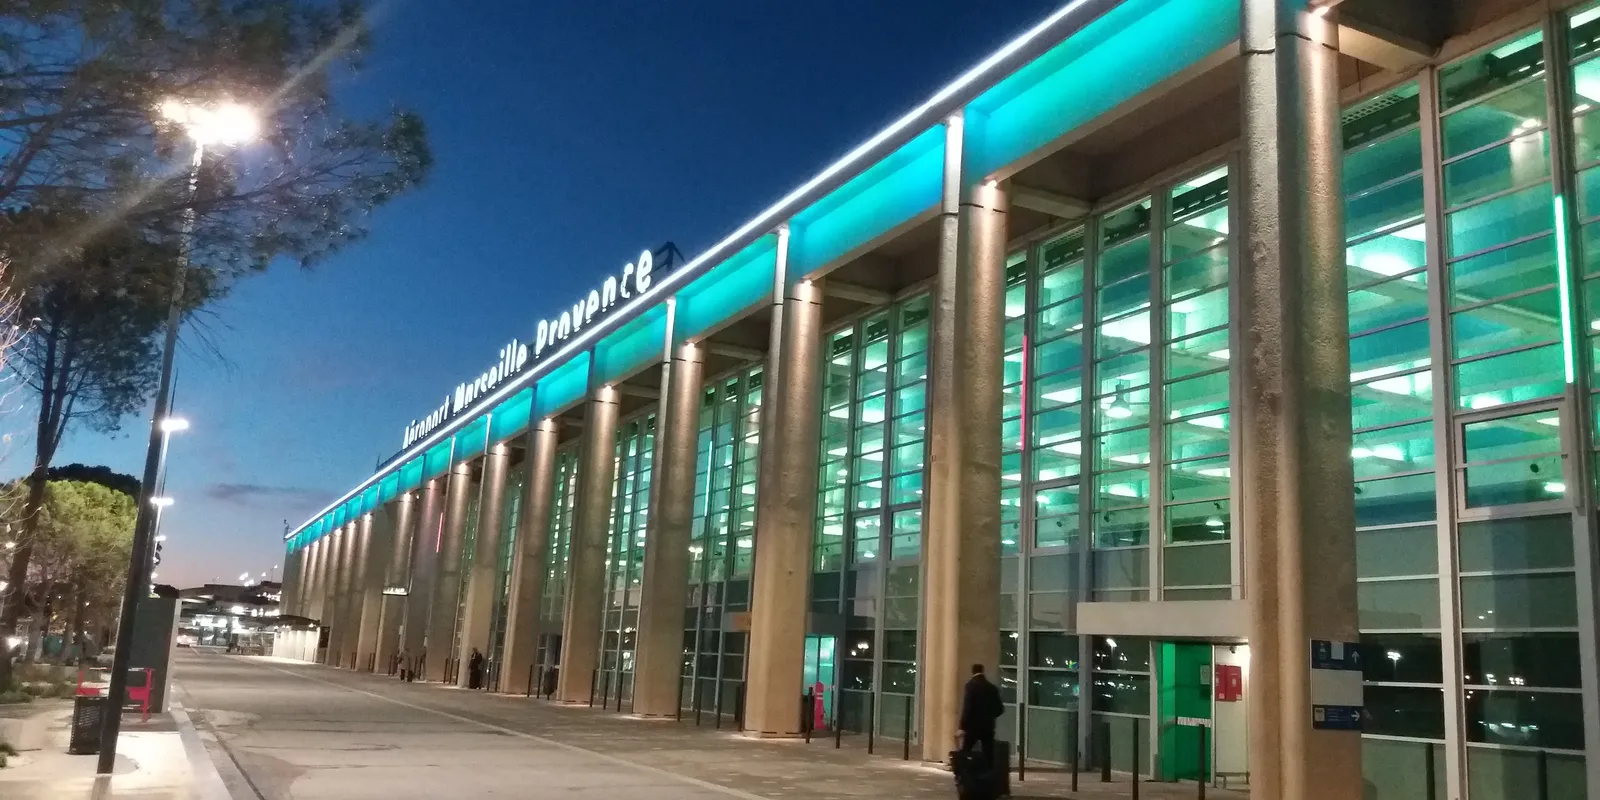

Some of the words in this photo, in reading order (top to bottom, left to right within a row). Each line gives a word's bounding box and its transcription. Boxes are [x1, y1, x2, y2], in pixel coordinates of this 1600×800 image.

[402, 395, 450, 450] Aéroport
[453, 338, 527, 416] Marseille
[535, 249, 653, 359] Provence
